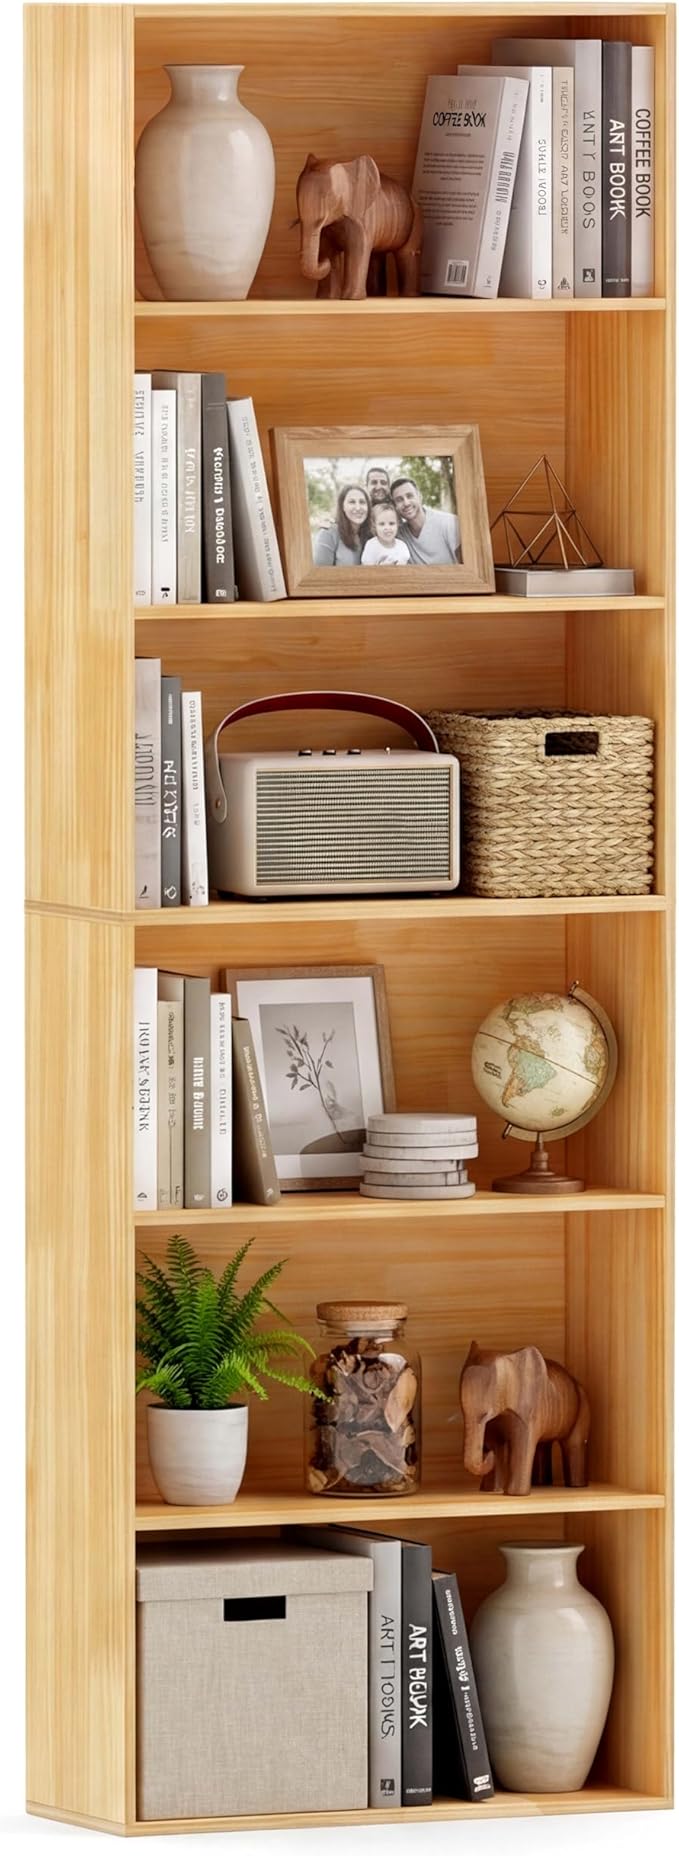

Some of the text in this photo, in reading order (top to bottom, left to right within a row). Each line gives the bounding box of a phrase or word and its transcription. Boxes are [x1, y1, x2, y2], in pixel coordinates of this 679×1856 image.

[635, 109, 651, 218] COFFEE BOOK
[409, 1623, 428, 1662] ART
